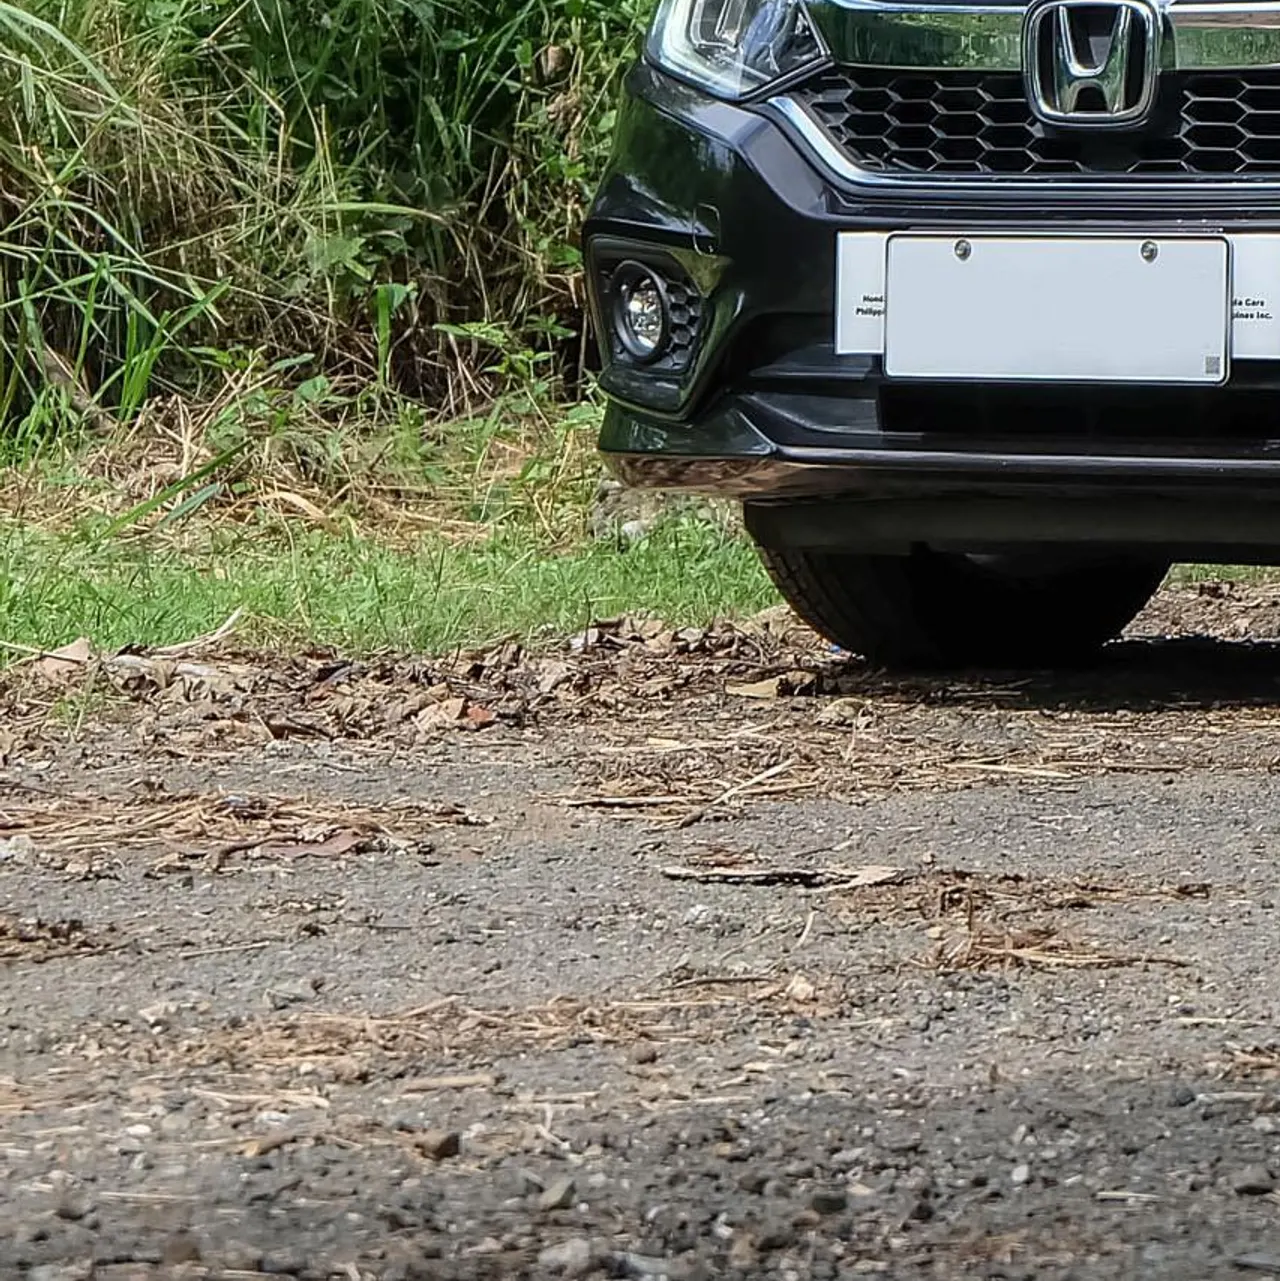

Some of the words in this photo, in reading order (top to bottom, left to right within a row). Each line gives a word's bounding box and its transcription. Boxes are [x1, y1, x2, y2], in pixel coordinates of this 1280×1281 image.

[1245, 298, 1265, 307] Cars
[855, 307, 886, 317] Philipp
[1256, 311, 1273, 319] Inc.
